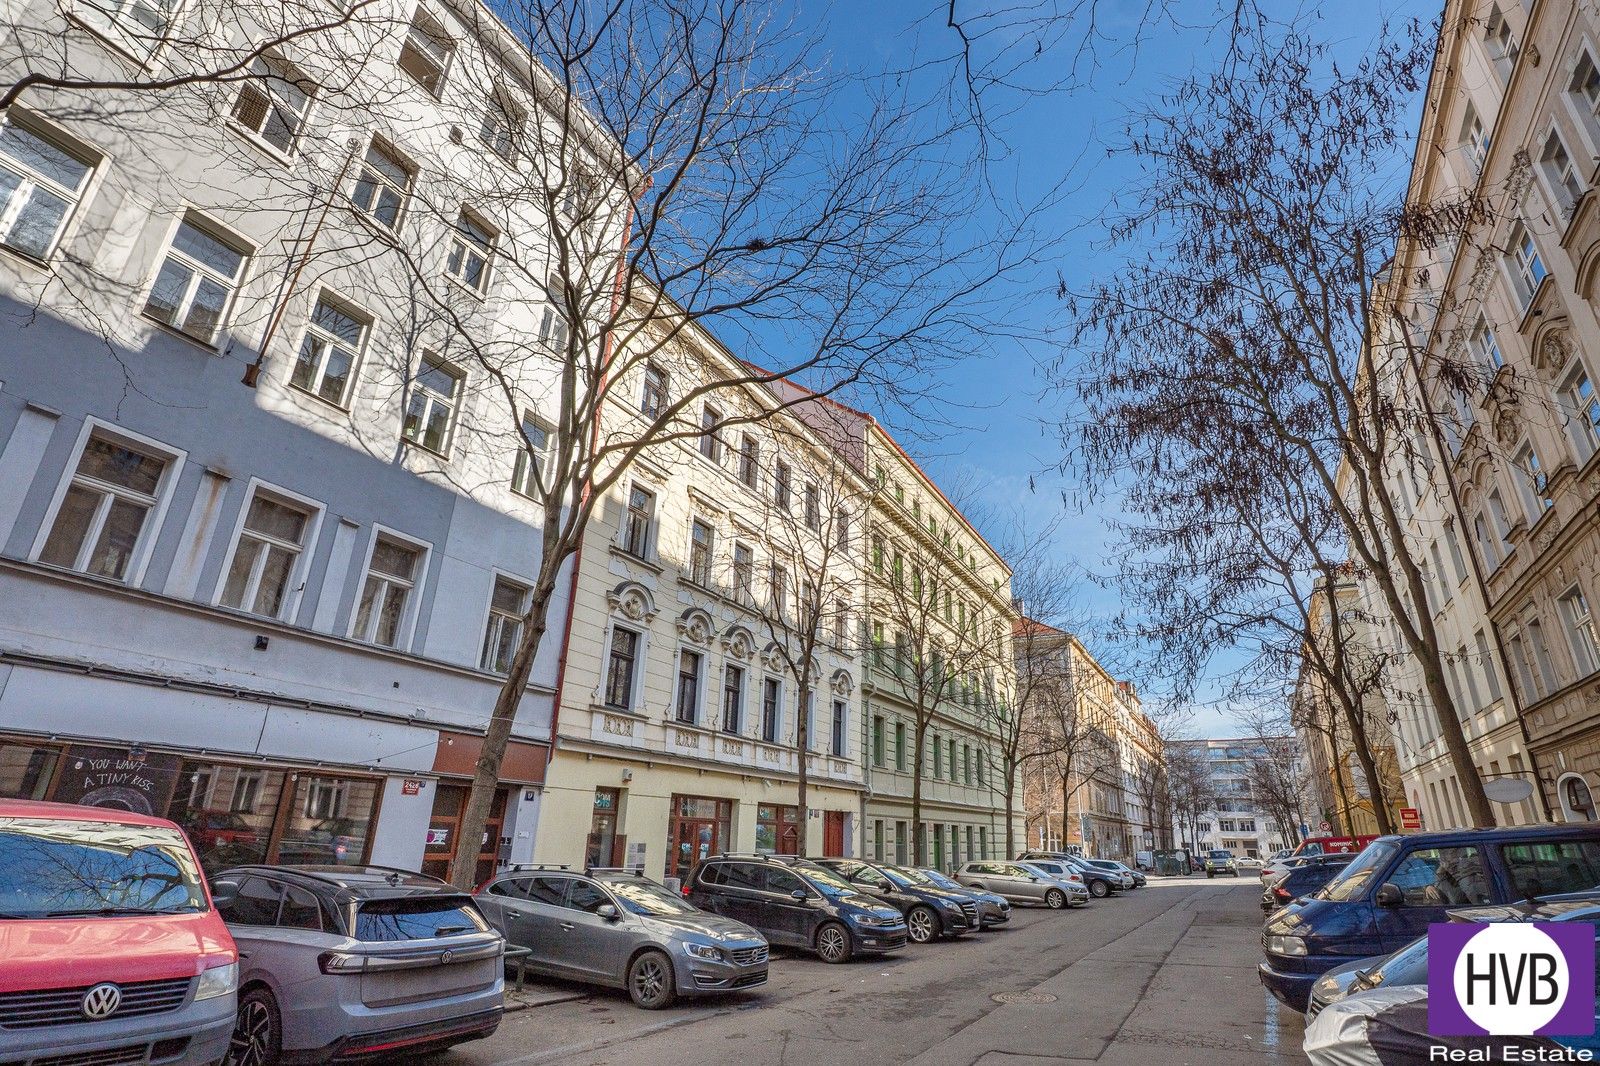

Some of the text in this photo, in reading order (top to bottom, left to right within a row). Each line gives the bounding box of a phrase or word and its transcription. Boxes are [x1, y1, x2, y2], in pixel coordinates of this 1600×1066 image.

[89, 759, 147, 771] YOU WANT
[84, 773, 154, 791] A TINY KISS
